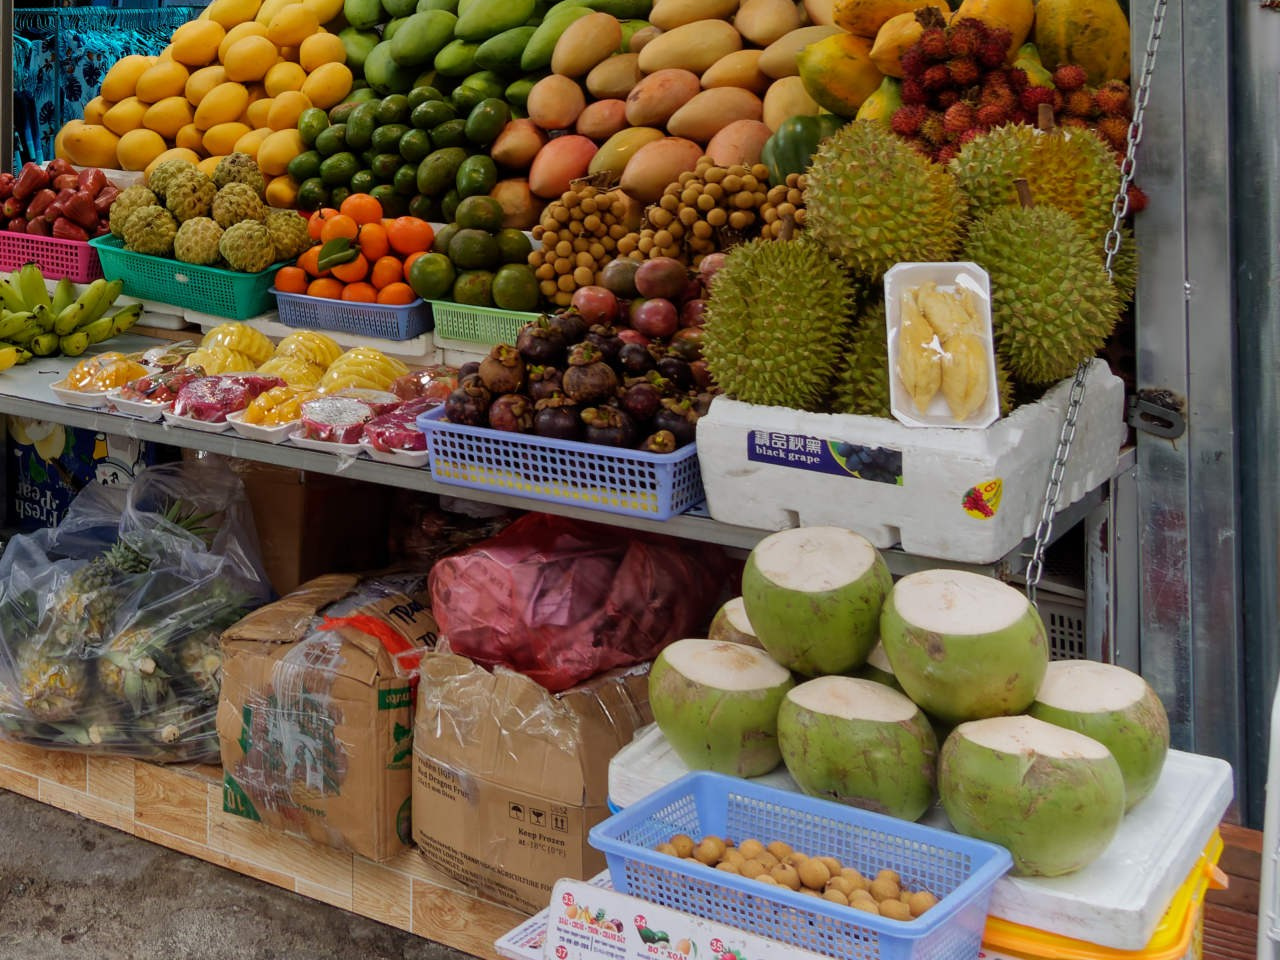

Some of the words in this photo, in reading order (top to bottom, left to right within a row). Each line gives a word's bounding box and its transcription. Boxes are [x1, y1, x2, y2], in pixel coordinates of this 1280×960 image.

[755, 445, 786, 458] black
[788, 453, 821, 464] grape
[15, 498, 58, 529] Fresh
[428, 771, 453, 792] Dragon
[538, 833, 565, 847] Frozen
